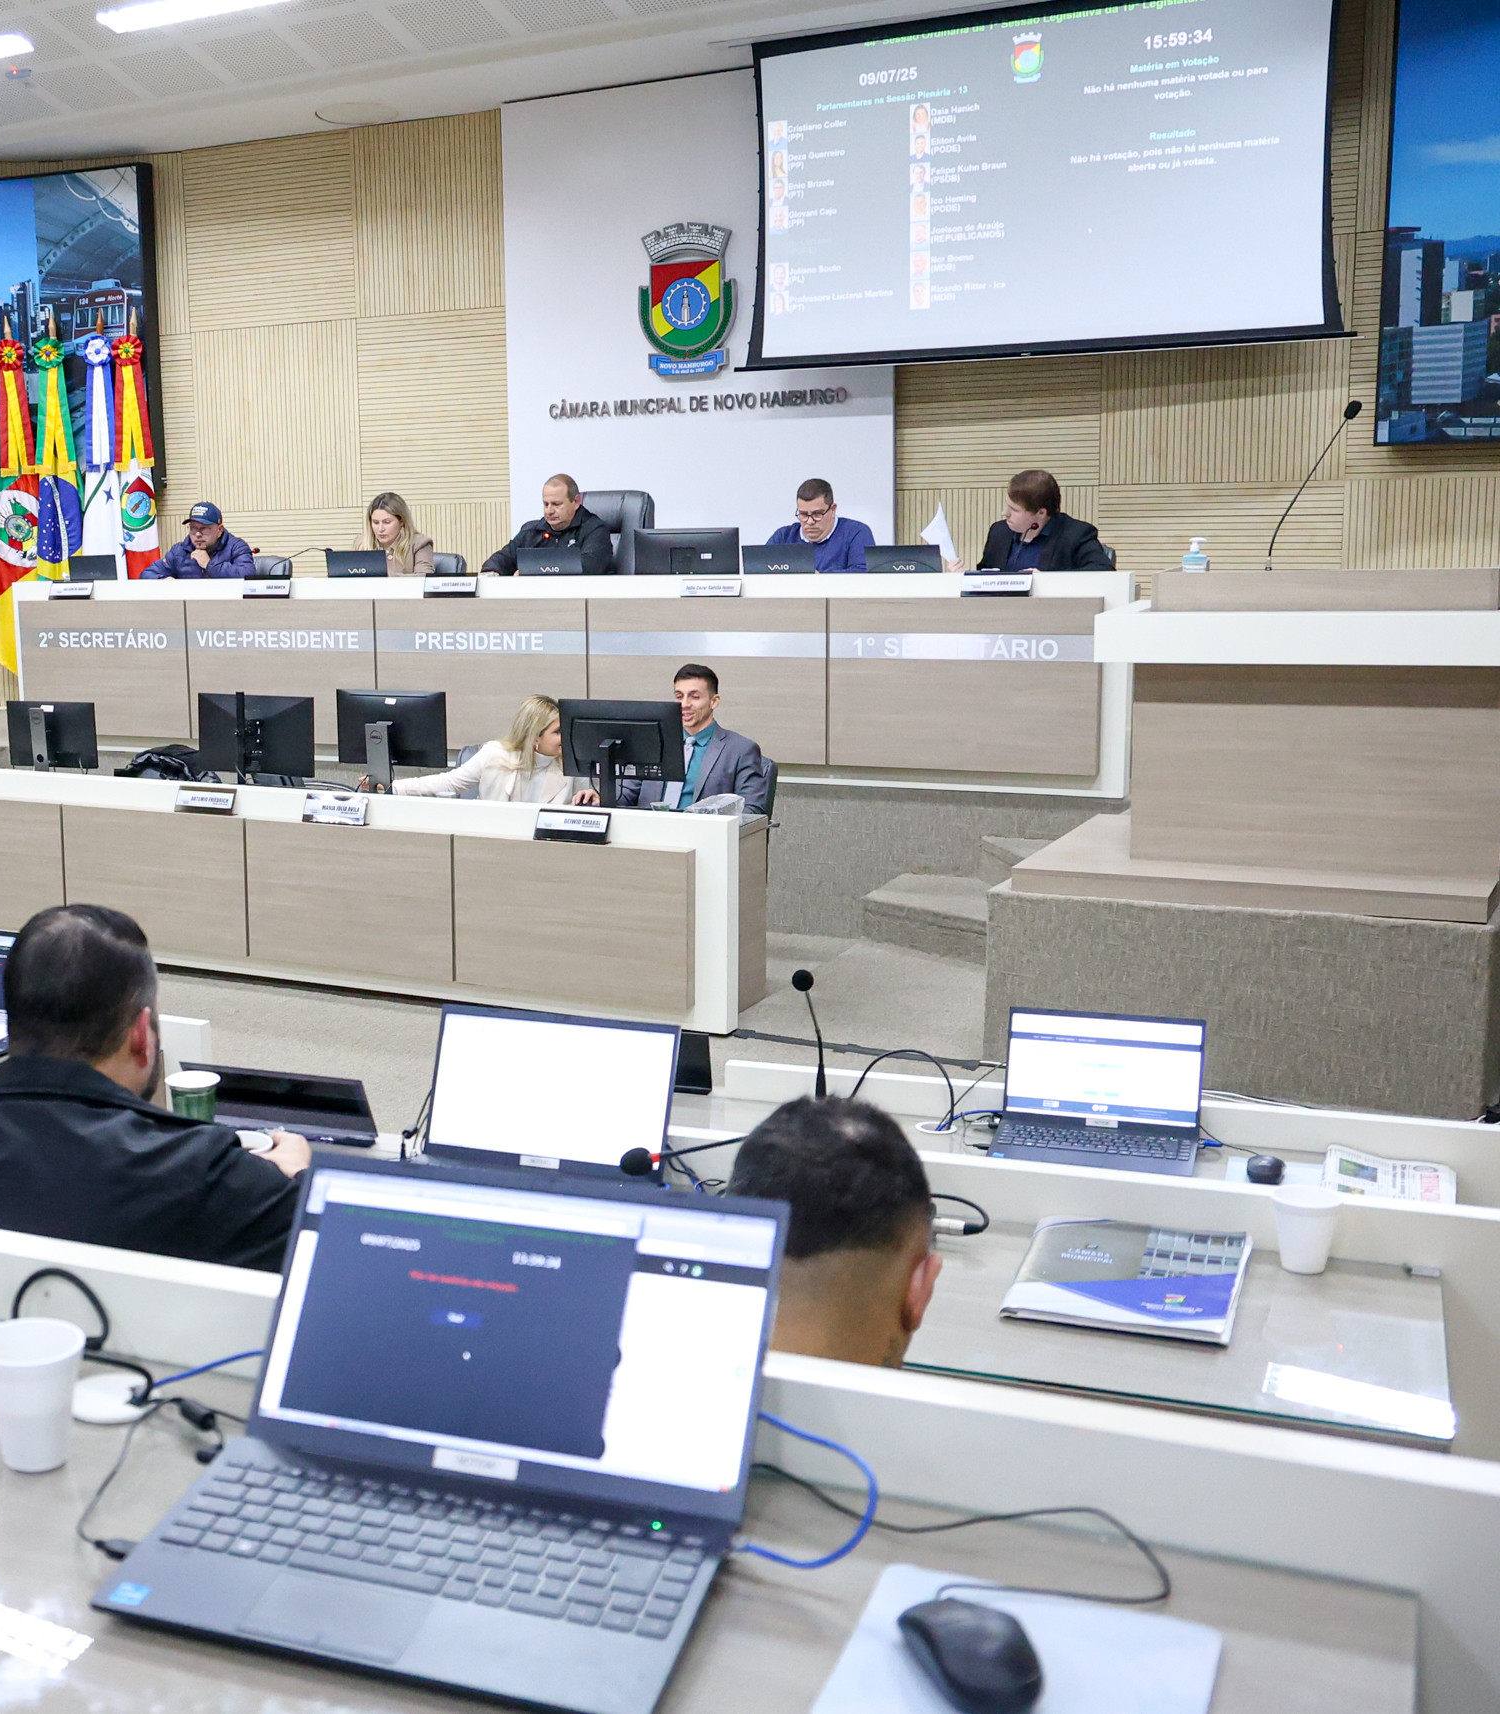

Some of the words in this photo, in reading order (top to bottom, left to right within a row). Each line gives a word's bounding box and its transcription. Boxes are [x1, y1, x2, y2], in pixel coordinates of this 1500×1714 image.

[1143, 28, 1213, 50] 15:59:34
[1129, 62, 1164, 74] Matéria
[1165, 60, 1180, 70] em
[1182, 54, 1220, 68] Votação
[859, 67, 918, 86] 09/07/25
[1083, 84, 1102, 95] Não
[1103, 81, 1115, 93] há
[1117, 77, 1159, 91] nenhuma
[1161, 72, 1196, 86] matéria
[1198, 69, 1230, 82] votada
[1232, 68, 1245, 78] ou
[1246, 65, 1269, 79] para
[816, 98, 872, 112] Parlamentares
[874, 97, 884, 105] na
[886, 92, 916, 103] Sessão
[918, 88, 951, 100] Plenária
[959, 85, 968, 95] 13
[1154, 88, 1193, 101] votação.
[787, 122, 822, 133] Cristiano
[823, 119, 847, 129] Coller
[931, 115, 956, 126] (MDB)
[1149, 128, 1196, 141] Resultado
[931, 144, 961, 156] (PODE)
[1070, 154, 1088, 165] Não
[1090, 151, 1101, 162] há
[1103, 148, 1141, 162] votação,
[1143, 145, 1163, 159] pois
[1165, 144, 1182, 156] não
[1184, 142, 1196, 153] há
[1198, 138, 1242, 152] nenhuma
[1244, 134, 1280, 147] matéria
[1128, 161, 1156, 172] aberta
[1158, 160, 1170, 169] ou
[1171, 158, 1181, 171] já
[1183, 155, 1217, 167] votada.
[931, 229, 1005, 244] (REPUBLICANOS)
[549, 397, 610, 420] CÂMARA
[613, 397, 686, 418] MUNICIPAL
[689, 395, 708, 412] DE
[713, 391, 756, 411] NOVO
[760, 386, 847, 409] HAMBURGO
[38, 630, 54, 648] 2º
[58, 628, 168, 650] SECRETÁRIO
[196, 629, 360, 650] VICE-PRESIDENTE
[414, 631, 544, 652] PRESIDENTE
[852, 637, 876, 657] 1º
[883, 633, 1059, 660] SETÁRIO
